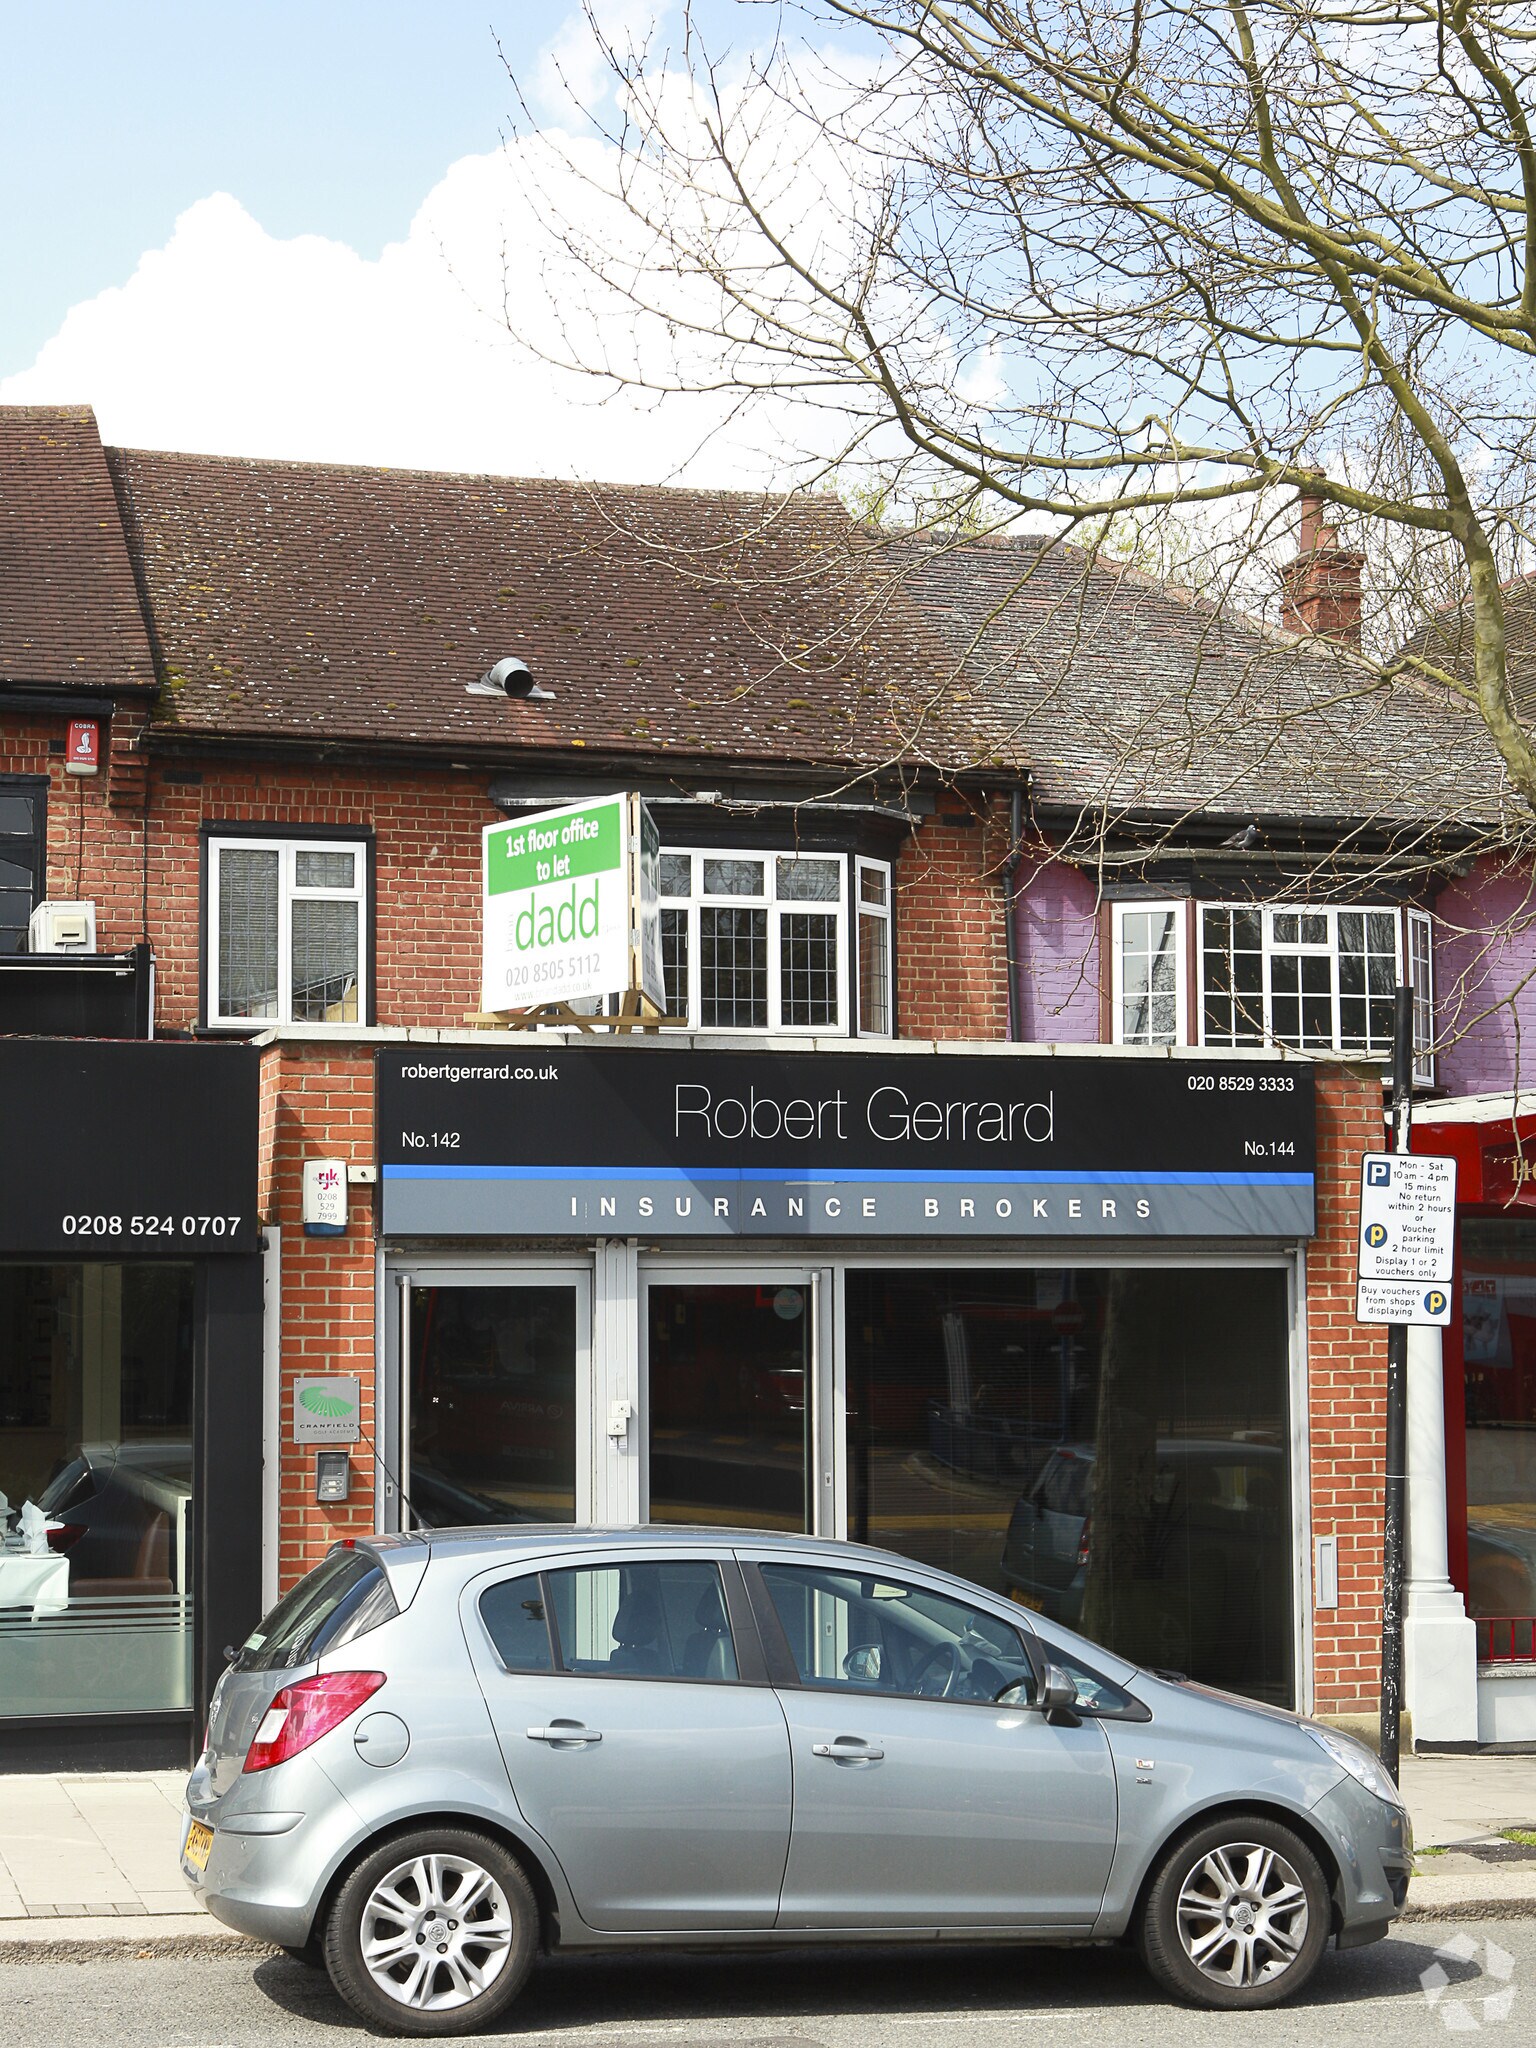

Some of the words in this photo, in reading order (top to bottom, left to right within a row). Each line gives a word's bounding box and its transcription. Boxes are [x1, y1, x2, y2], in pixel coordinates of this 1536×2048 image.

[506, 835, 525, 858] 1st
[528, 826, 559, 853] floor
[562, 817, 599, 846] office
[536, 862, 551, 882] to
[553, 854, 570, 877] let
[515, 878, 599, 951] dadd
[506, 966, 528, 987] 020
[533, 959, 564, 983] 8505
[569, 953, 600, 977] 5112
[401, 1064, 559, 1082] robertgerrard.co.uk
[1187, 1076, 1214, 1091] 020
[1219, 1076, 1255, 1092] 8529
[1258, 1077, 1295, 1092] 3333
[673, 1083, 849, 1140] Robert
[866, 1086, 1055, 1143] Gerrard
[402, 1131, 460, 1149] No.142
[1244, 1141, 1295, 1157] No.144
[1400, 1161, 1417, 1169] Mon
[1429, 1163, 1443, 1171] Sat
[1399, 1193, 1412, 1201] No
[570, 1196, 877, 1218] INSURANCE
[924, 1198, 1151, 1219] BROKERS
[1388, 1203, 1415, 1211] within
[1428, 1204, 1452, 1213] hours
[62, 1215, 123, 1235] 0208
[130, 1216, 174, 1235] 524
[182, 1216, 241, 1236] 0707
[1402, 1225, 1436, 1233] Voucher
[1402, 1235, 1435, 1244] parking
[1402, 1245, 1421, 1253] hour
[1424, 1246, 1444, 1254] limit
[1376, 1256, 1408, 1267] Display
[1412, 1258, 1415, 1266] 1
[1376, 1268, 1414, 1276] vouchers
[1419, 1269, 1436, 1278] only
[1362, 1286, 1377, 1295] Buy
[1366, 1296, 1386, 1304] from
[1390, 1298, 1415, 1306] shops
[1368, 1307, 1413, 1317] displaying
